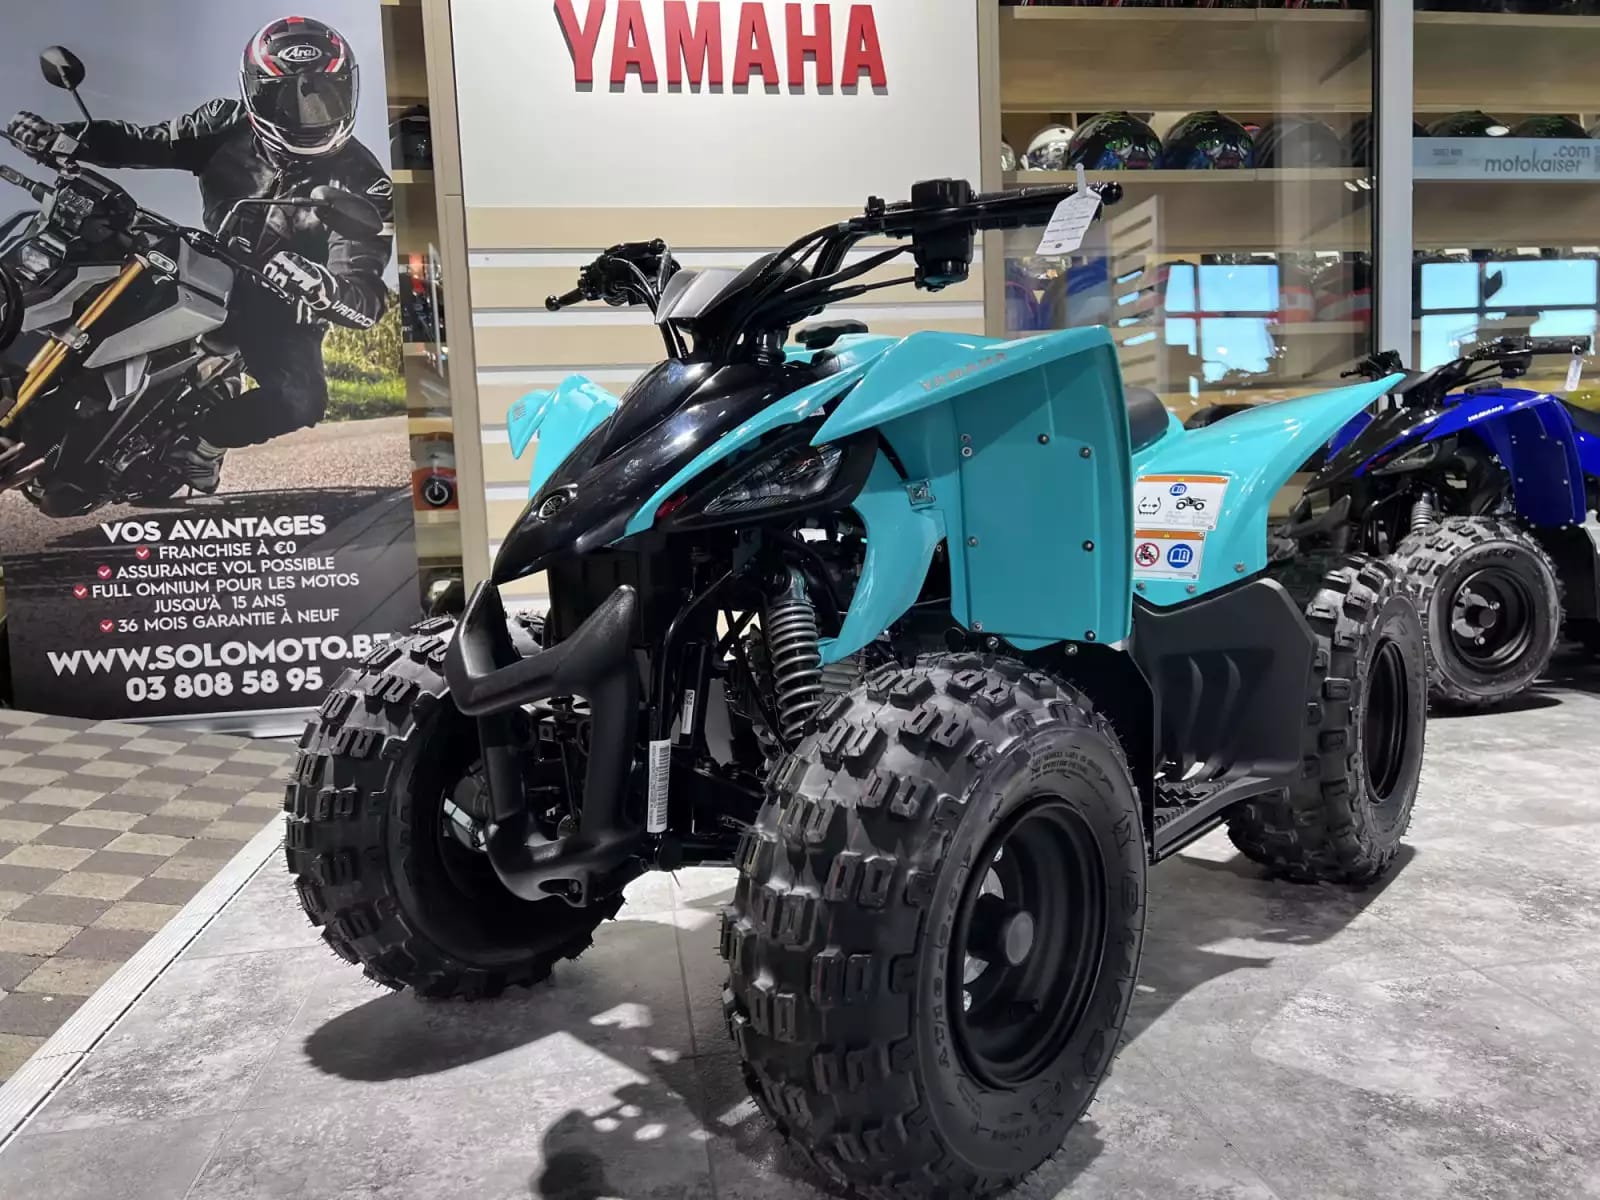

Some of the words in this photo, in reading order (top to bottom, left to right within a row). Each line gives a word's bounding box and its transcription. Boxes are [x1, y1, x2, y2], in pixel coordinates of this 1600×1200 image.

[284, 46, 317, 59] Arai
[553, 0, 888, 92] YAMAHA
[1484, 147, 1581, 173] motokaiser
[1553, 143, 1591, 158] .com
[100, 521, 161, 543] VOS
[168, 514, 326, 541] AVANTAGES
[159, 542, 252, 560] FRANCHISE
[256, 540, 270, 555] À
[274, 541, 297, 555] €0
[116, 561, 218, 580] ASSURANCE
[222, 560, 256, 574] VOL
[261, 556, 335, 572] POSSIBLE
[92, 583, 132, 598] FULL
[136, 580, 210, 596] OMNIUM
[216, 577, 262, 593] POUR
[268, 575, 296, 590] LES
[301, 573, 359, 588] MOTOS
[154, 594, 221, 614] JUSQU'À
[231, 595, 247, 609] 15
[252, 593, 287, 608] ANS
[117, 618, 139, 633] 36
[144, 616, 188, 632] MOIS
[192, 611, 276, 628] GARANTIE
[280, 608, 293, 624] À
[298, 608, 340, 623] NEUF
[125, 676, 167, 702] 03
[173, 671, 234, 698] 808
[241, 669, 280, 695] 58
[285, 666, 324, 692] 95
